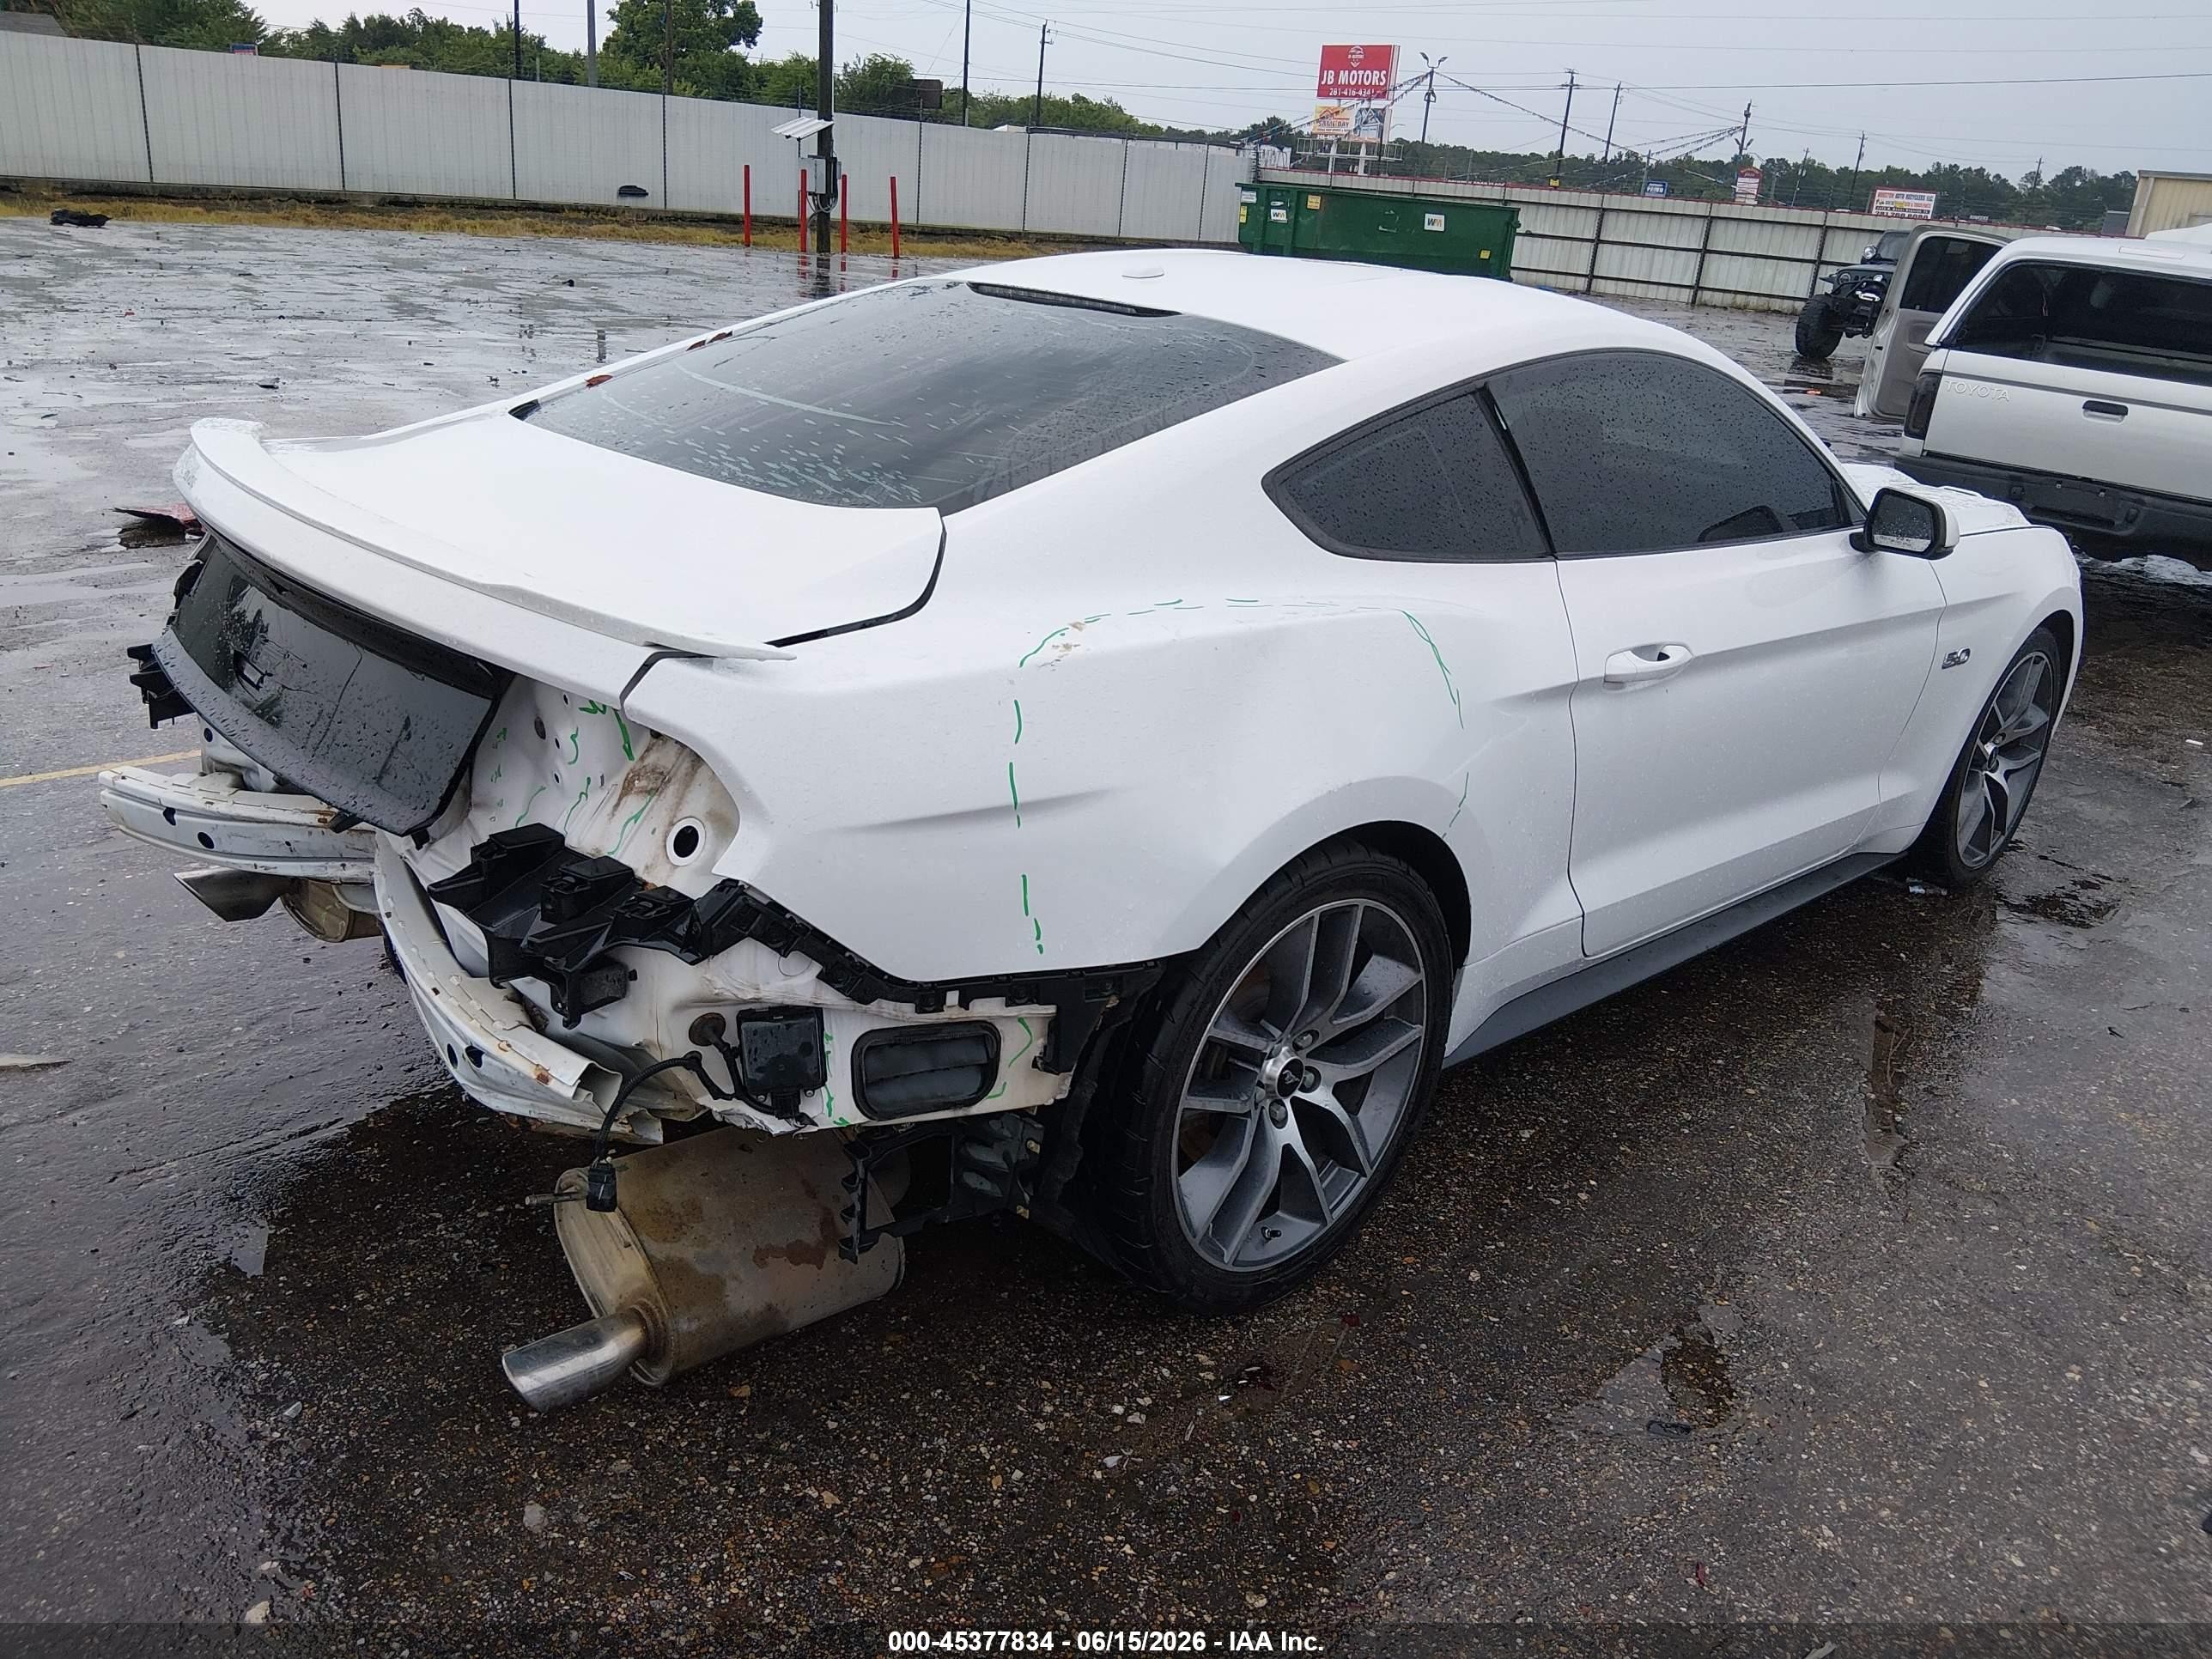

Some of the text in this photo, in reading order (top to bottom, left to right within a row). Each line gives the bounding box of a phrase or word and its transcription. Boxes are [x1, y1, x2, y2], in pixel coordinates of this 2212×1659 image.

[1322, 70, 1387, 86] JB MOTORS
[1427, 217, 1442, 228] WM
[1944, 380, 2009, 402] TOYOTA
